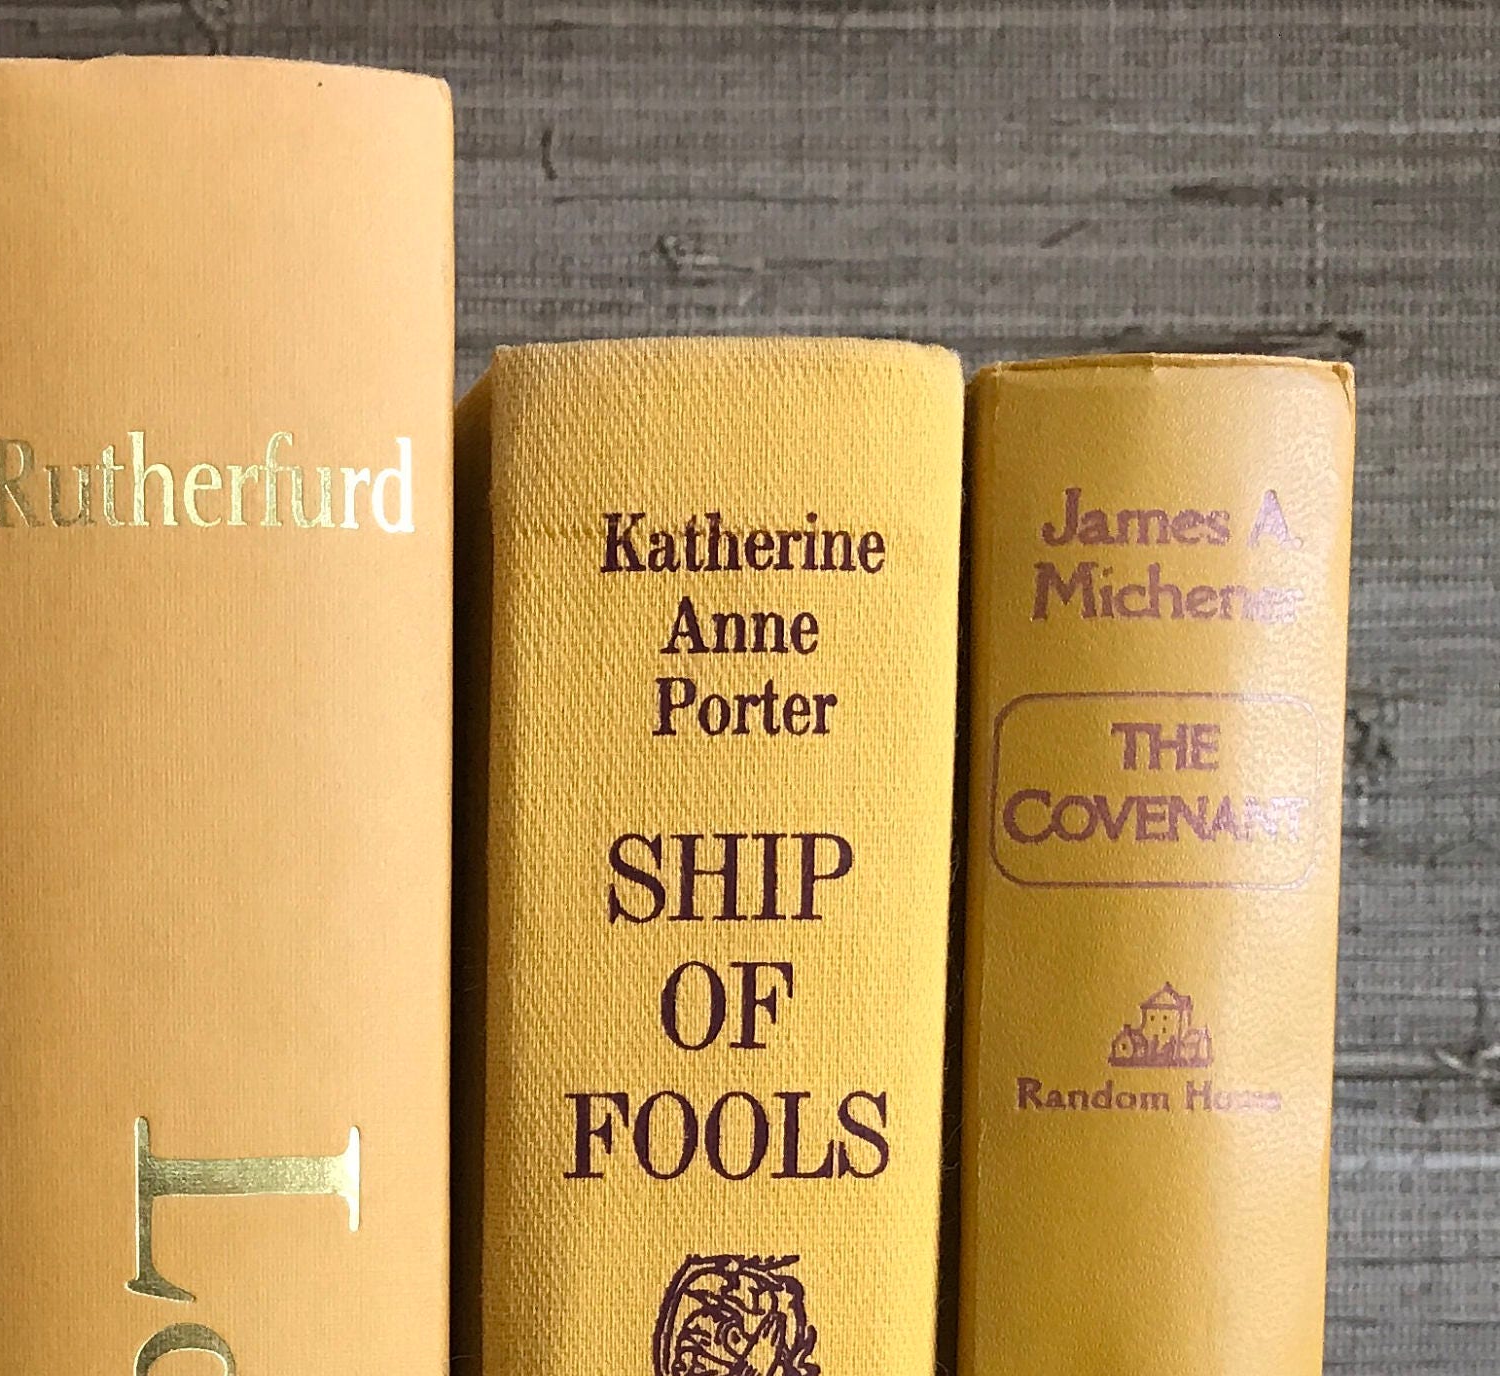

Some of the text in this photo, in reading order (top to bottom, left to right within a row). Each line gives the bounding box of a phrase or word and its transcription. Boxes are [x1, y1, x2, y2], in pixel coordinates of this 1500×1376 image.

[600, 511, 887, 574] Katherine
[1040, 486, 1231, 547] James
[659, 596, 821, 655] Anne
[652, 676, 839, 737] Porter
[1110, 722, 1222, 773] THE
[607, 832, 854, 925] SHIP
[660, 960, 795, 1052] OF
[1015, 1076, 1172, 1112] Random
[563, 1090, 890, 1181] FOOLS
